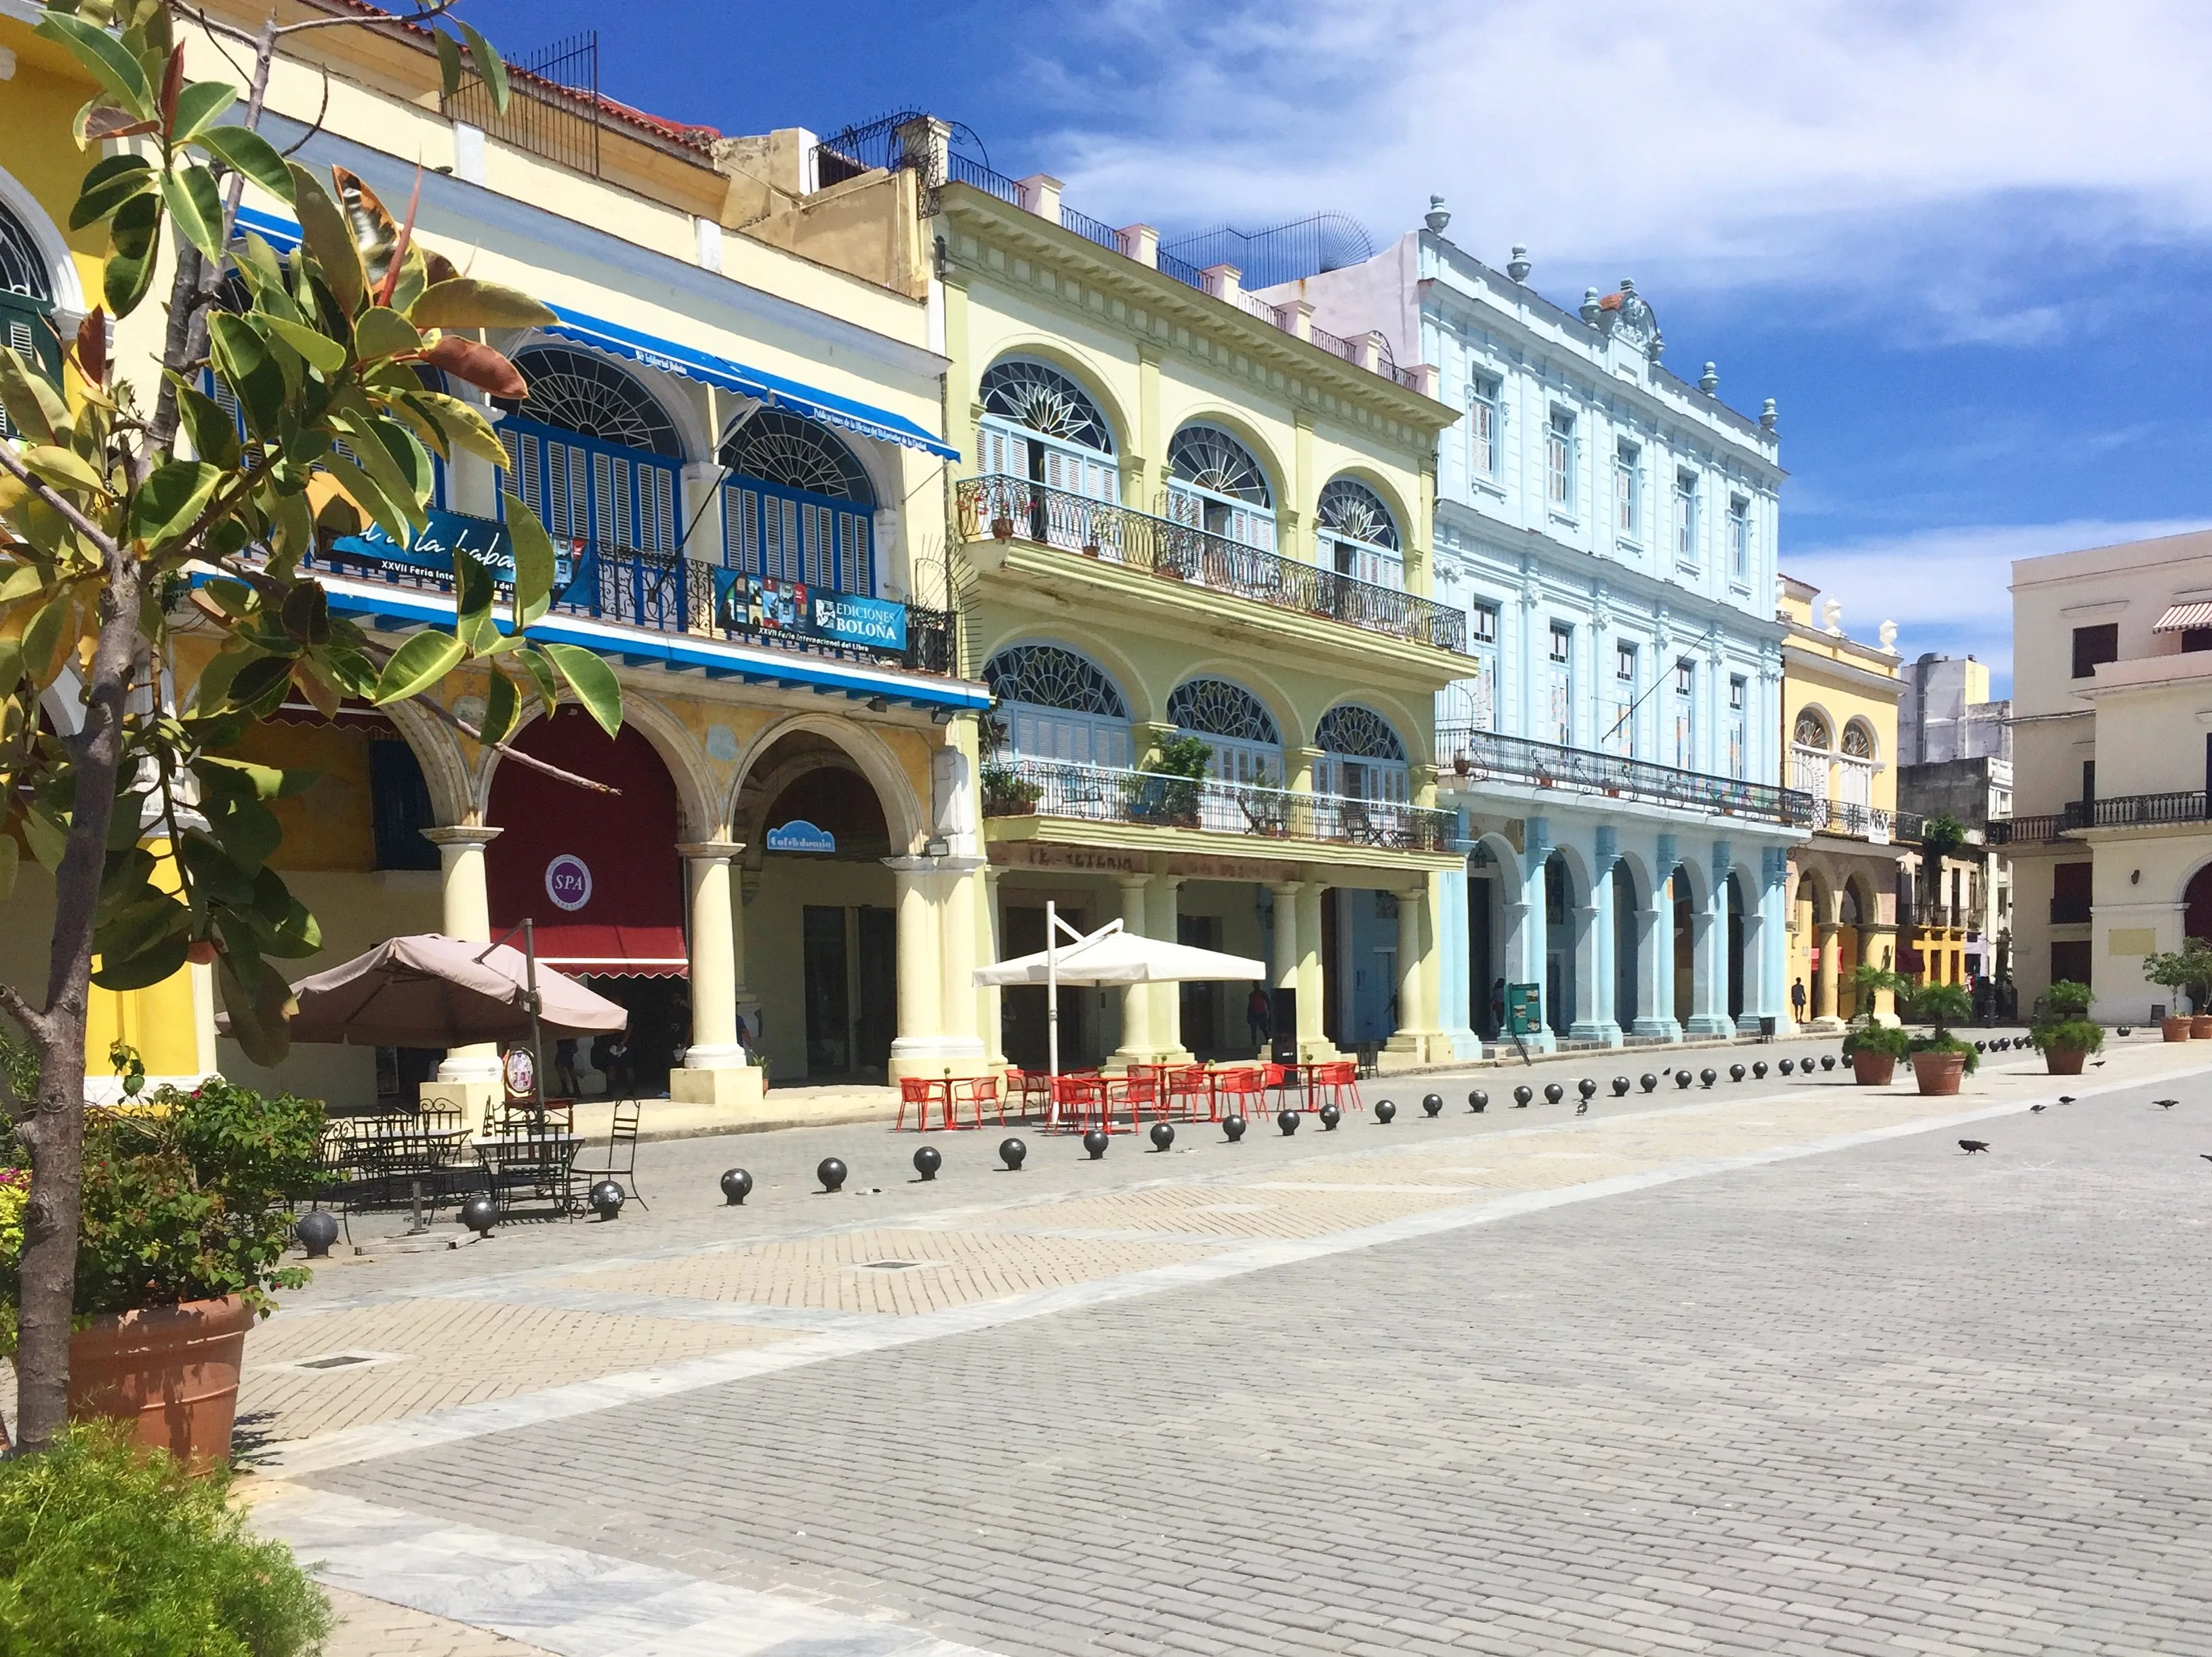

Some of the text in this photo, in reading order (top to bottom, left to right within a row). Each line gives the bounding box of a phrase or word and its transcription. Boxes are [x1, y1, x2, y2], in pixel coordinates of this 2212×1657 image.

[414, 521, 445, 552] la
[382, 560, 434, 577] XXVII Feria
[499, 581, 513, 591] del
[836, 602, 895, 623] EDICIONES
[836, 617, 897, 640] BOLOÑA
[758, 628, 869, 652] XXVII Feria Internacional del Libro
[555, 874, 583, 891] SPA
